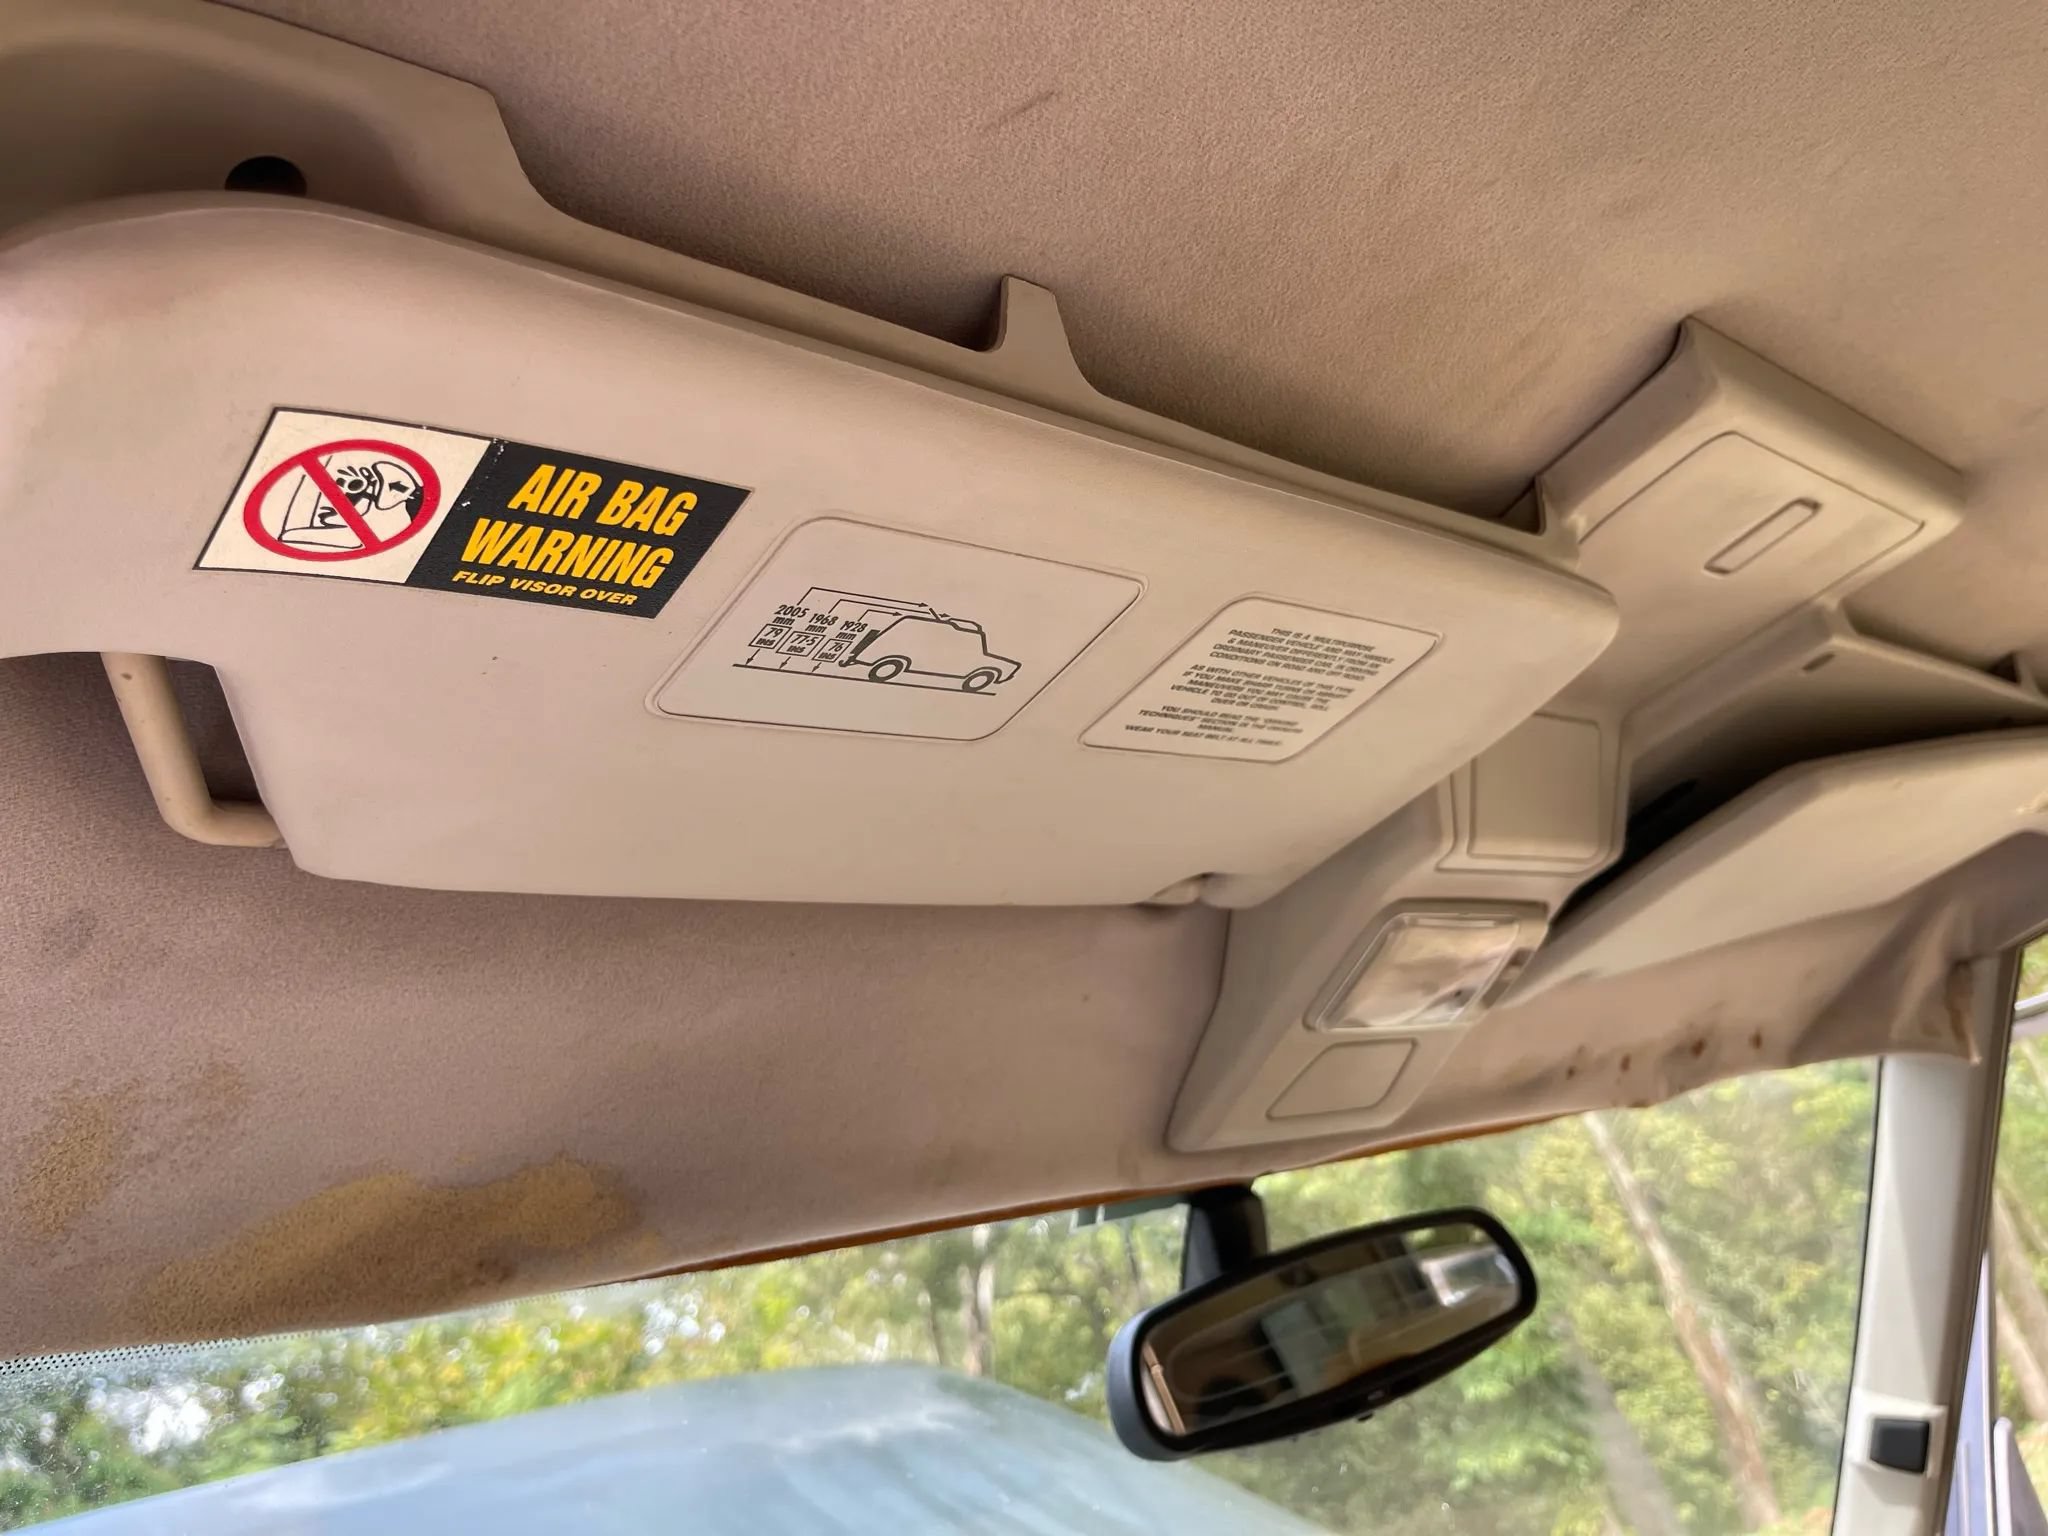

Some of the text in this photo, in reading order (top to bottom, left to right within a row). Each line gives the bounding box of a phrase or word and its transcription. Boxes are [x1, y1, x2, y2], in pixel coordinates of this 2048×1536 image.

[507, 464, 697, 537] AIR BAG
[461, 518, 674, 589] WARNING
[452, 570, 638, 606] FLIP VISOR OVER
[774, 604, 810, 618] 2005
[772, 616, 796, 626] mm
[808, 613, 839, 626] 1968
[763, 627, 784, 638] 79
[804, 624, 827, 634] mm
[840, 620, 868, 633] 1928
[835, 631, 857, 641] mm
[1228, 629, 1285, 643] PASSENGER
[828, 641, 844, 653] 76
[1209, 651, 1267, 664] CONDITIONS
[1195, 672, 1215, 680] YOU
[1170, 684, 1209, 694] VEHICLE
